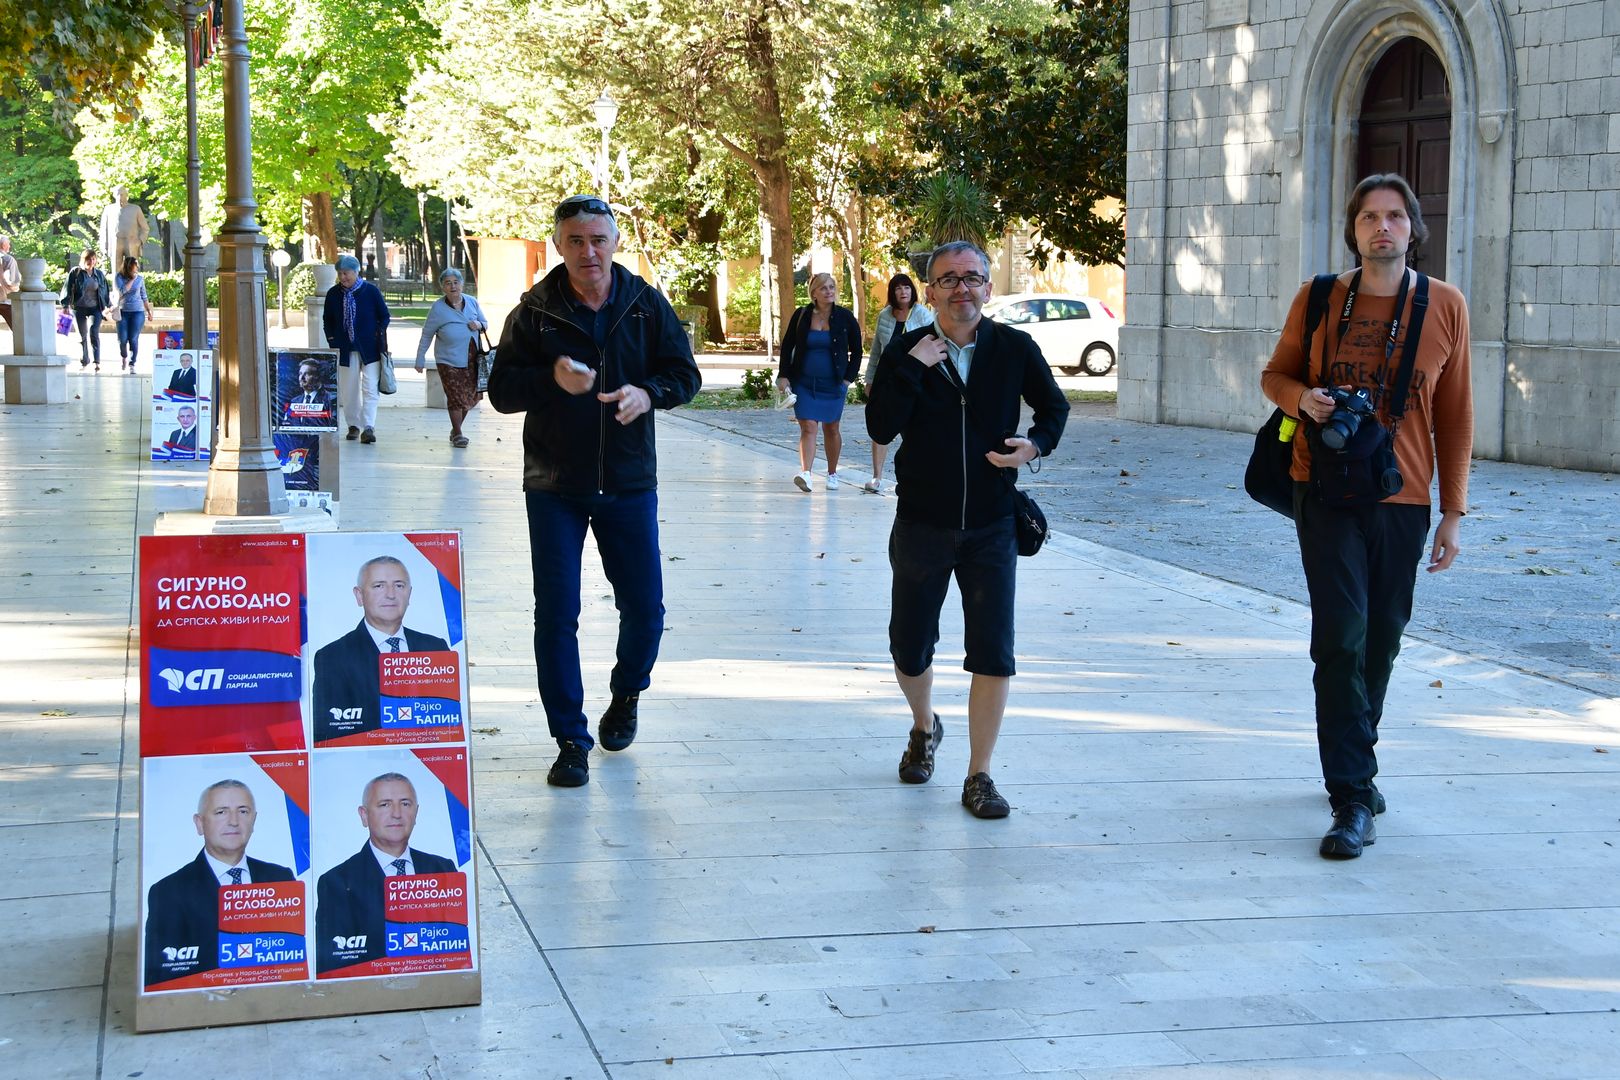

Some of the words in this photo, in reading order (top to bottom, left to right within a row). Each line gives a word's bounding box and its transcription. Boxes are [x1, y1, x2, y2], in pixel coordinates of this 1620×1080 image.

[1343, 291, 1354, 316] SONY
[158, 576, 247, 592] СИГУРНО
[158, 596, 170, 610] И
[176, 592, 291, 610] СЛОБОДНО
[157, 618, 172, 627] ДА
[175, 617, 217, 626] СРПСКА
[220, 616, 250, 625] ЖИВИ
[252, 616, 260, 624] И
[262, 615, 290, 624] РАДИ
[384, 657, 431, 666] СИГУРНО
[394, 666, 455, 676] СЛОБОДНО
[185, 668, 225, 690] СП
[228, 672, 293, 680] СОЦИЈАЛИСТИЧКА
[342, 708, 363, 719] СП
[383, 706, 396, 723] 5.
[414, 702, 442, 713] Рајко
[414, 714, 459, 724] ЋАПИН
[389, 879, 438, 890] СИГУРНО
[224, 888, 275, 900] СИГУРНО
[390, 892, 396, 901] И
[400, 888, 463, 900] СЛОБОДНО
[224, 902, 231, 911] И
[234, 897, 300, 910] СЛОБОДНО
[346, 935, 367, 948] СП
[388, 933, 402, 951] 5.
[420, 926, 448, 939] Рајко
[420, 939, 467, 951] ЋАПИН
[177, 946, 199, 959] СП
[221, 944, 236, 962] 5.
[255, 937, 285, 949] Рајко
[255, 950, 304, 963] ЋАПИН
